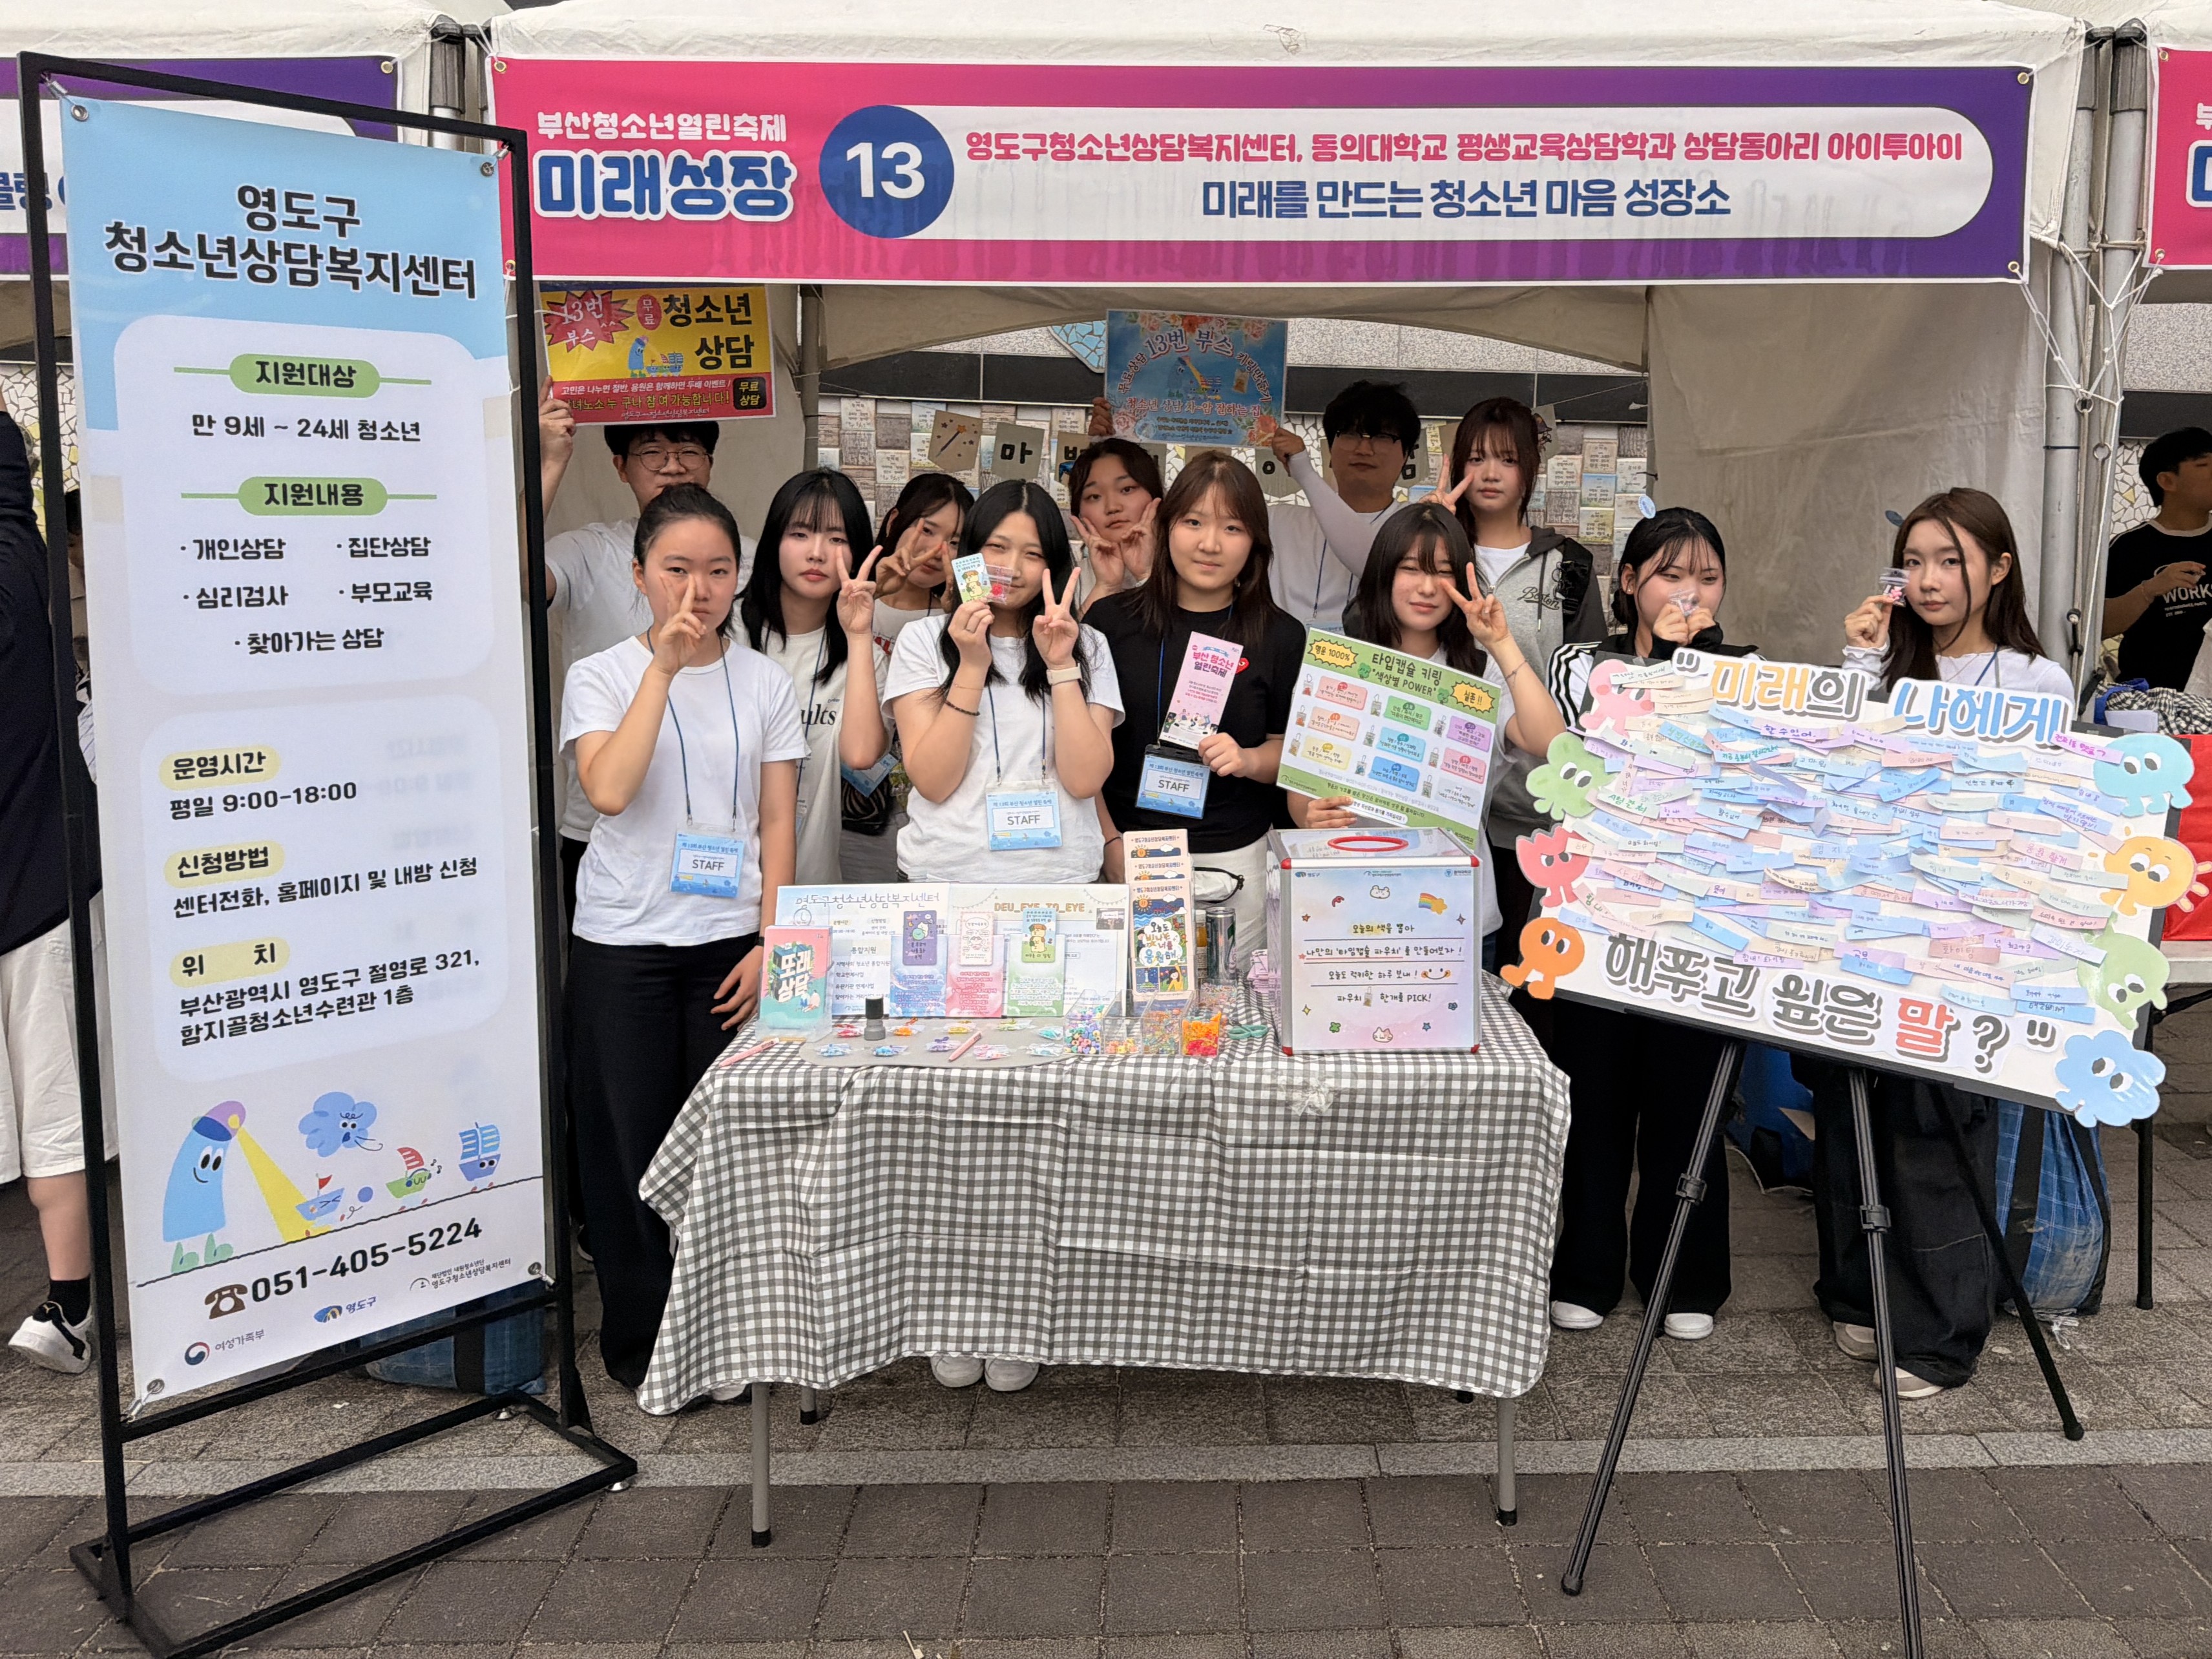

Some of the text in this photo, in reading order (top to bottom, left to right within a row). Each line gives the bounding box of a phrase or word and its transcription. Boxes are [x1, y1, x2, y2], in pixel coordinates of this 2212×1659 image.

[537, 112, 786, 141] 부산청소년열린축제
[966, 132, 1961, 162] 영도구청소년상담복지센터, 동의대학교 평생교육상담학과 상담동아리 아이투아이
[846, 141, 925, 198] 13
[535, 151, 796, 219] 미래성장
[1202, 179, 1730, 219] 미래를 만드는 청소년 마음 성장소
[235, 184, 361, 238] 영도구
[103, 220, 478, 301] 청소년상담복지센터
[663, 293, 753, 328] 청소년
[564, 329, 596, 347] 부스
[694, 335, 755, 370] 상담
[1145, 328, 1235, 359] 13번 부스
[255, 361, 357, 388] 지원대상
[739, 381, 759, 392] 무료
[739, 395, 760, 406] 상담
[1127, 397, 1158, 412] 청소년
[1162, 399, 1183, 413] 상담
[1216, 402, 1247, 417] 잘하는
[1250, 404, 1261, 419] 집
[193, 414, 216, 437] 만
[225, 417, 265, 437] 9세
[297, 419, 348, 440] 24세
[358, 419, 421, 443] 청소년
[264, 483, 364, 506] 지원내용
[342, 628, 384, 649] 상담
[1193, 652, 1234, 670] 부산 청소년
[1328, 647, 1351, 662] 1000%
[1421, 667, 1443, 687] 키링
[1894, 682, 2066, 746] 나에게
[172, 751, 266, 780] 운영시간
[1158, 780, 1189, 792] STAFF
[169, 782, 357, 820] 평일 9:00-18:00
[1008, 815, 1040, 825] STAFF
[178, 846, 269, 879] 신청방법
[693, 859, 724, 871] STAFF
[173, 857, 478, 919] 센터전화, 홈페이지 및 내방 신청
[795, 893, 939, 910] 영도구청소년상담복지센터
[1353, 924, 1373, 934] 오늘의
[1377, 924, 1392, 934] 색을
[182, 943, 276, 977] 위 치
[780, 950, 811, 979] 또래
[1306, 947, 1333, 956] 나만의
[1414, 945, 1454, 955] 만들어보자
[180, 950, 480, 1019] 부산광역시 영도구 절영로 321,
[778, 973, 809, 1002] 상담
[1329, 970, 1346, 979] 오늘도
[1350, 970, 1373, 979] 럭키한
[1378, 969, 1392, 979] 하루
[1396, 969, 1411, 979] 보내
[1337, 992, 1432, 1002] 파우치 한개를 PICK!
[180, 985, 413, 1047] 함지골청소년수련관 1층
[251, 1217, 482, 1304] 051-405-5224
[346, 1295, 377, 1315] 영도구
[214, 1329, 266, 1352] 여성가족부
